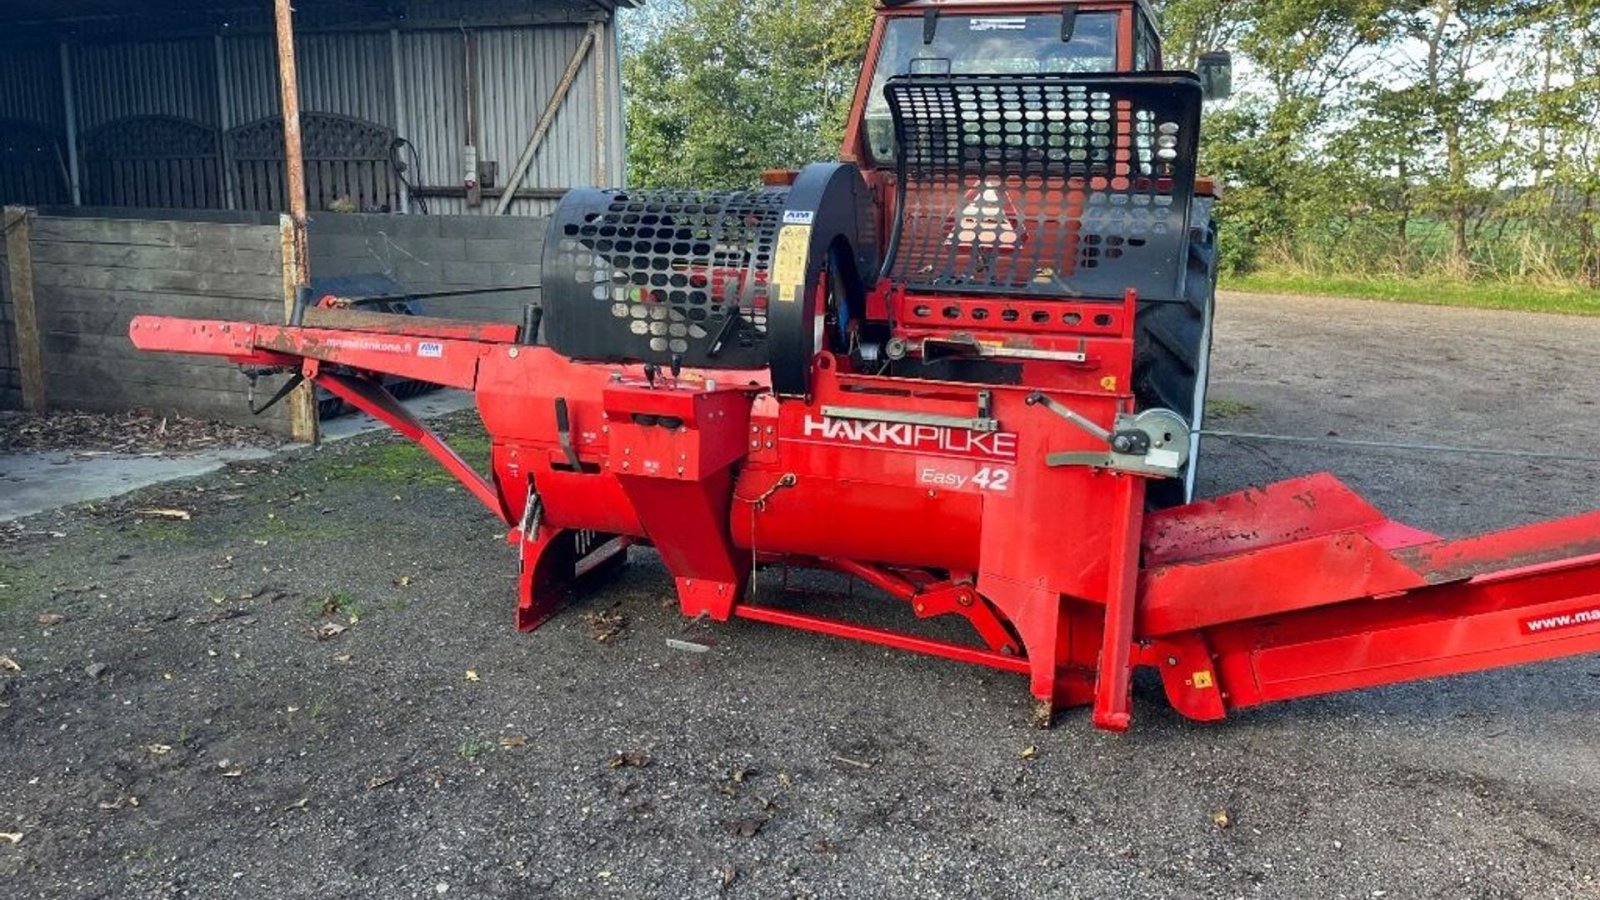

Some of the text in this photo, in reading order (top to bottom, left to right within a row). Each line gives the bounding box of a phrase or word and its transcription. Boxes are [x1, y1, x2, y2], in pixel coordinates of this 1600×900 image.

[920, 467, 1010, 491] Easy 42
[1526, 609, 1600, 631] www.ma
